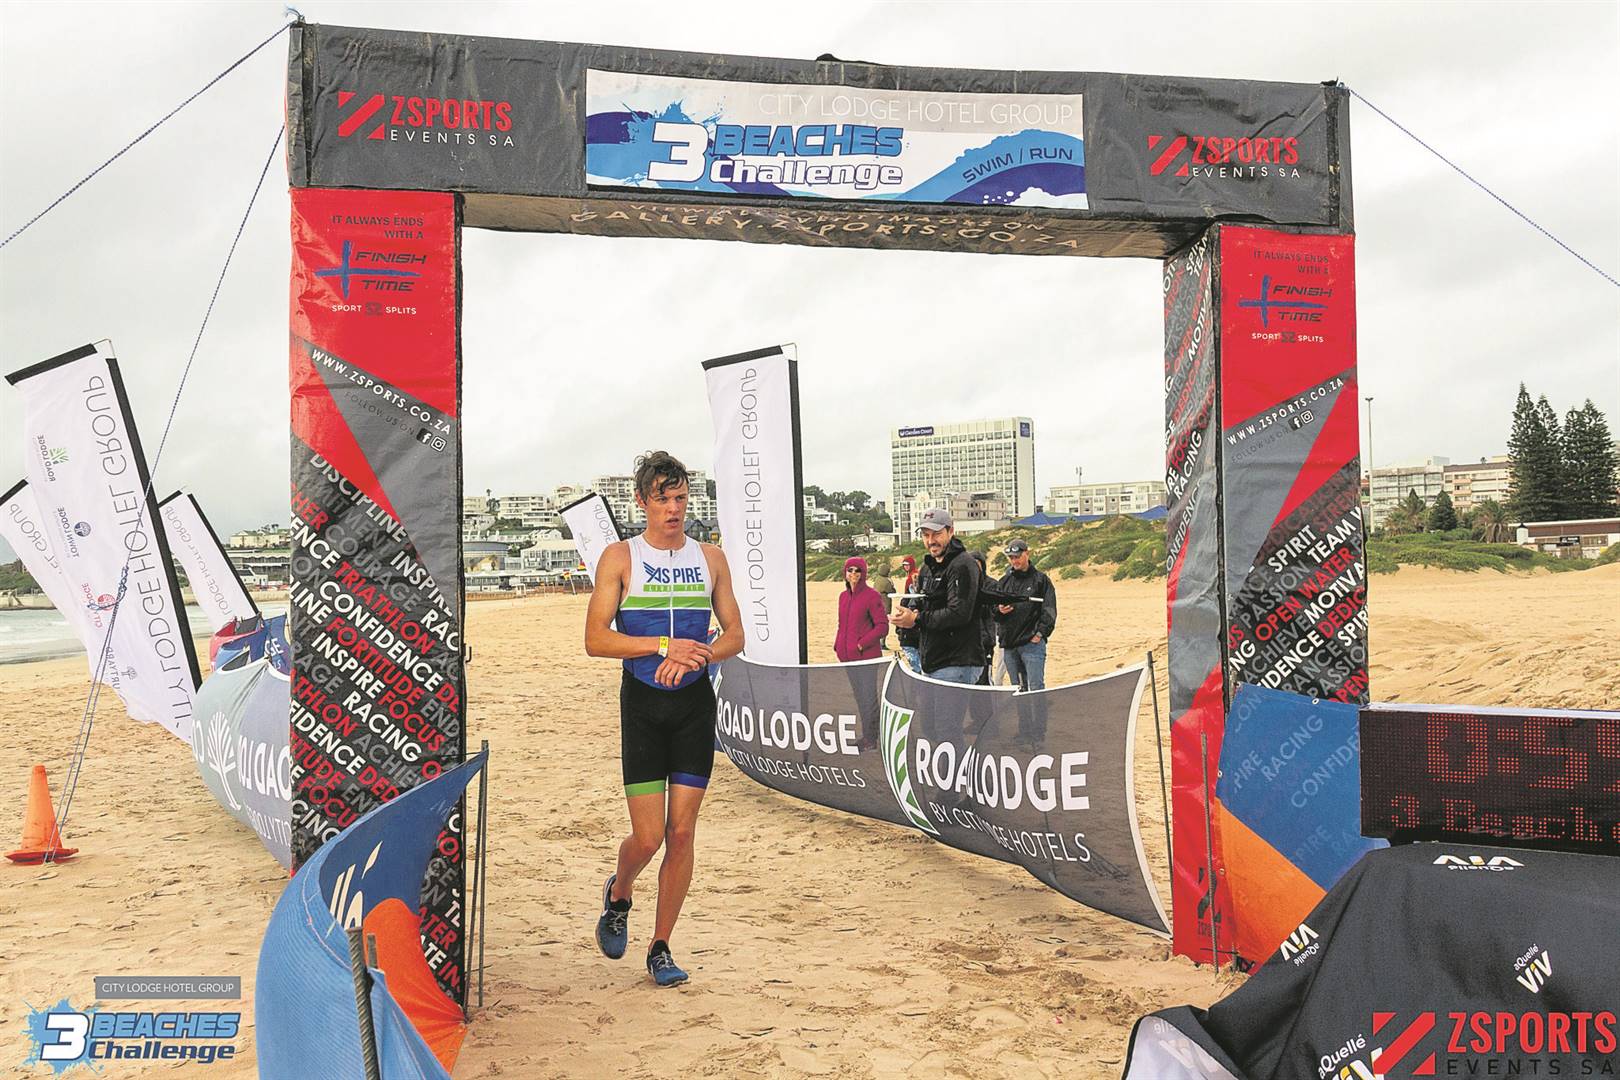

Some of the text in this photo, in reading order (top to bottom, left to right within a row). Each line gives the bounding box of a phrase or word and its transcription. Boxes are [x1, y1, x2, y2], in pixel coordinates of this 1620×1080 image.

[390, 96, 513, 132] ZSPORTS
[758, 93, 1074, 127] CITY LODGE HOTEL GROUP
[390, 129, 514, 147] EVENTS SA
[648, 121, 904, 183] 3 BEACHES
[1192, 136, 1299, 165] ZSPORTS
[709, 158, 904, 190] Challenge
[962, 152, 1015, 184] SWIM
[1029, 146, 1074, 163] RUN
[1192, 166, 1300, 178] EVENTS SA
[331, 215, 424, 227] IT ALWAYS ENDS
[384, 229, 424, 239] WITH A
[354, 250, 427, 265] FINISH
[1264, 251, 1302, 262] ALWAYS
[1304, 254, 1329, 264] ENDS
[1297, 265, 1321, 274] WITH
[361, 279, 414, 291] TIME
[1272, 285, 1333, 298] FINISH
[331, 304, 417, 315] SPORT SPLITS
[1277, 311, 1323, 322] TIME
[1251, 332, 1324, 343] SPORT SPLITS
[311, 348, 451, 436] WWW.ZSPORTS.CO.ZA
[344, 391, 382, 418] FOLLOW
[1227, 377, 1344, 446] WWW.ZSPORTS.CO.ZA
[309, 453, 407, 543] DISCIPLINE
[1267, 524, 1317, 573] SPIRIT
[325, 524, 422, 612] COURAGE
[642, 561, 704, 583] ASPIRE
[1240, 559, 1311, 629] PASSION
[1306, 518, 1357, 564] TEAM
[335, 561, 437, 656] TRIATHLON
[1255, 596, 1304, 641] OPEN
[1298, 547, 1355, 600] WATER
[319, 581, 444, 693] CONFIDENCE
[1242, 614, 1313, 683] ACHIEVE
[325, 616, 426, 706] FORTITUDE
[311, 631, 386, 699] INSPIRE
[378, 690, 447, 752] FOCUS
[342, 690, 422, 763] RACING
[718, 697, 861, 756] ROAD LODGE
[1260, 714, 1324, 783] RACING
[752, 754, 799, 780] LODGE
[795, 762, 867, 788] HOTELS
[972, 746, 1090, 812] LODGE
[1391, 792, 1420, 830] 3
[928, 801, 952, 825] BY
[1008, 829, 1091, 862] HOTELS
[1512, 943, 1539, 972] aQuellé
[1317, 1033, 1367, 1080] aQuellé
